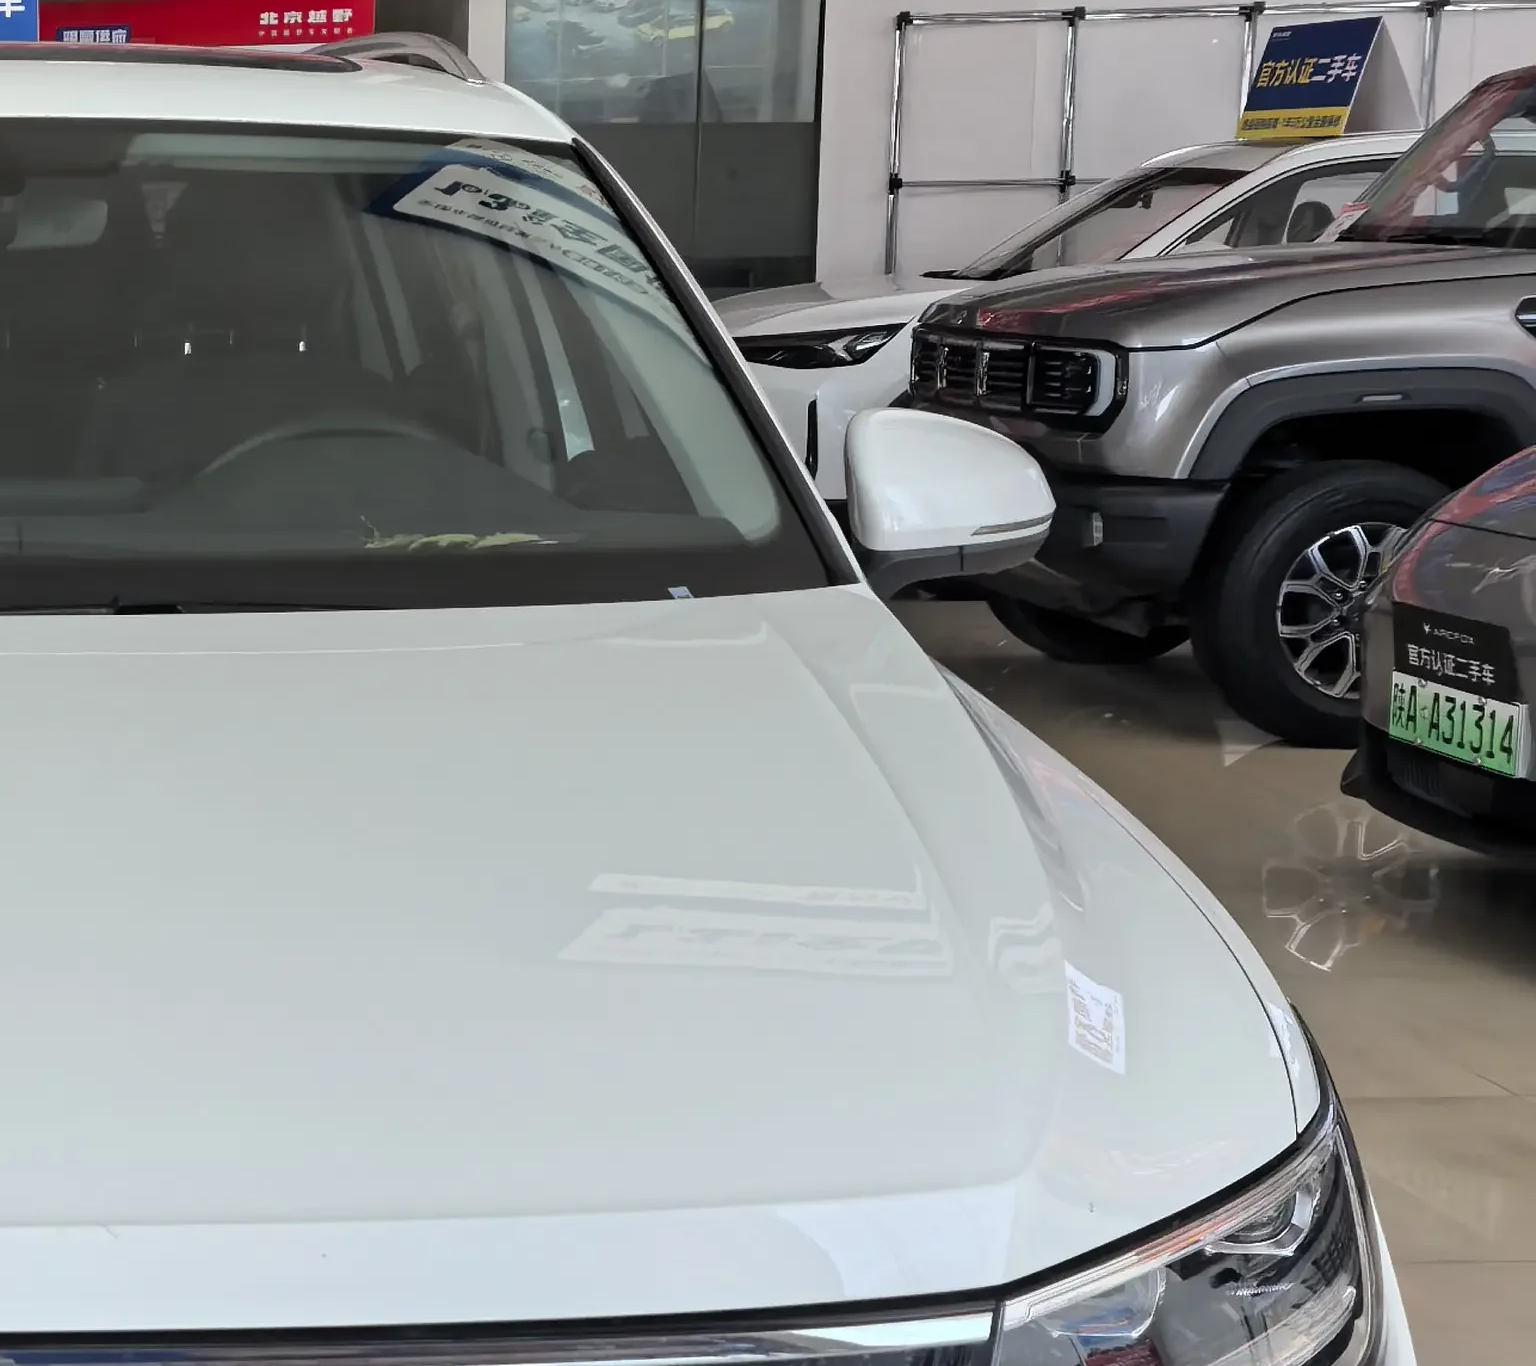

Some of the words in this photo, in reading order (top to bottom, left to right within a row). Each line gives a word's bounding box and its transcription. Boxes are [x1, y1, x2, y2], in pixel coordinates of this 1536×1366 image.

[259, 8, 353, 26] 北京越野
[1256, 53, 1363, 89] 官方认证二手车
[1407, 643, 1496, 686] 官方认证二手车
